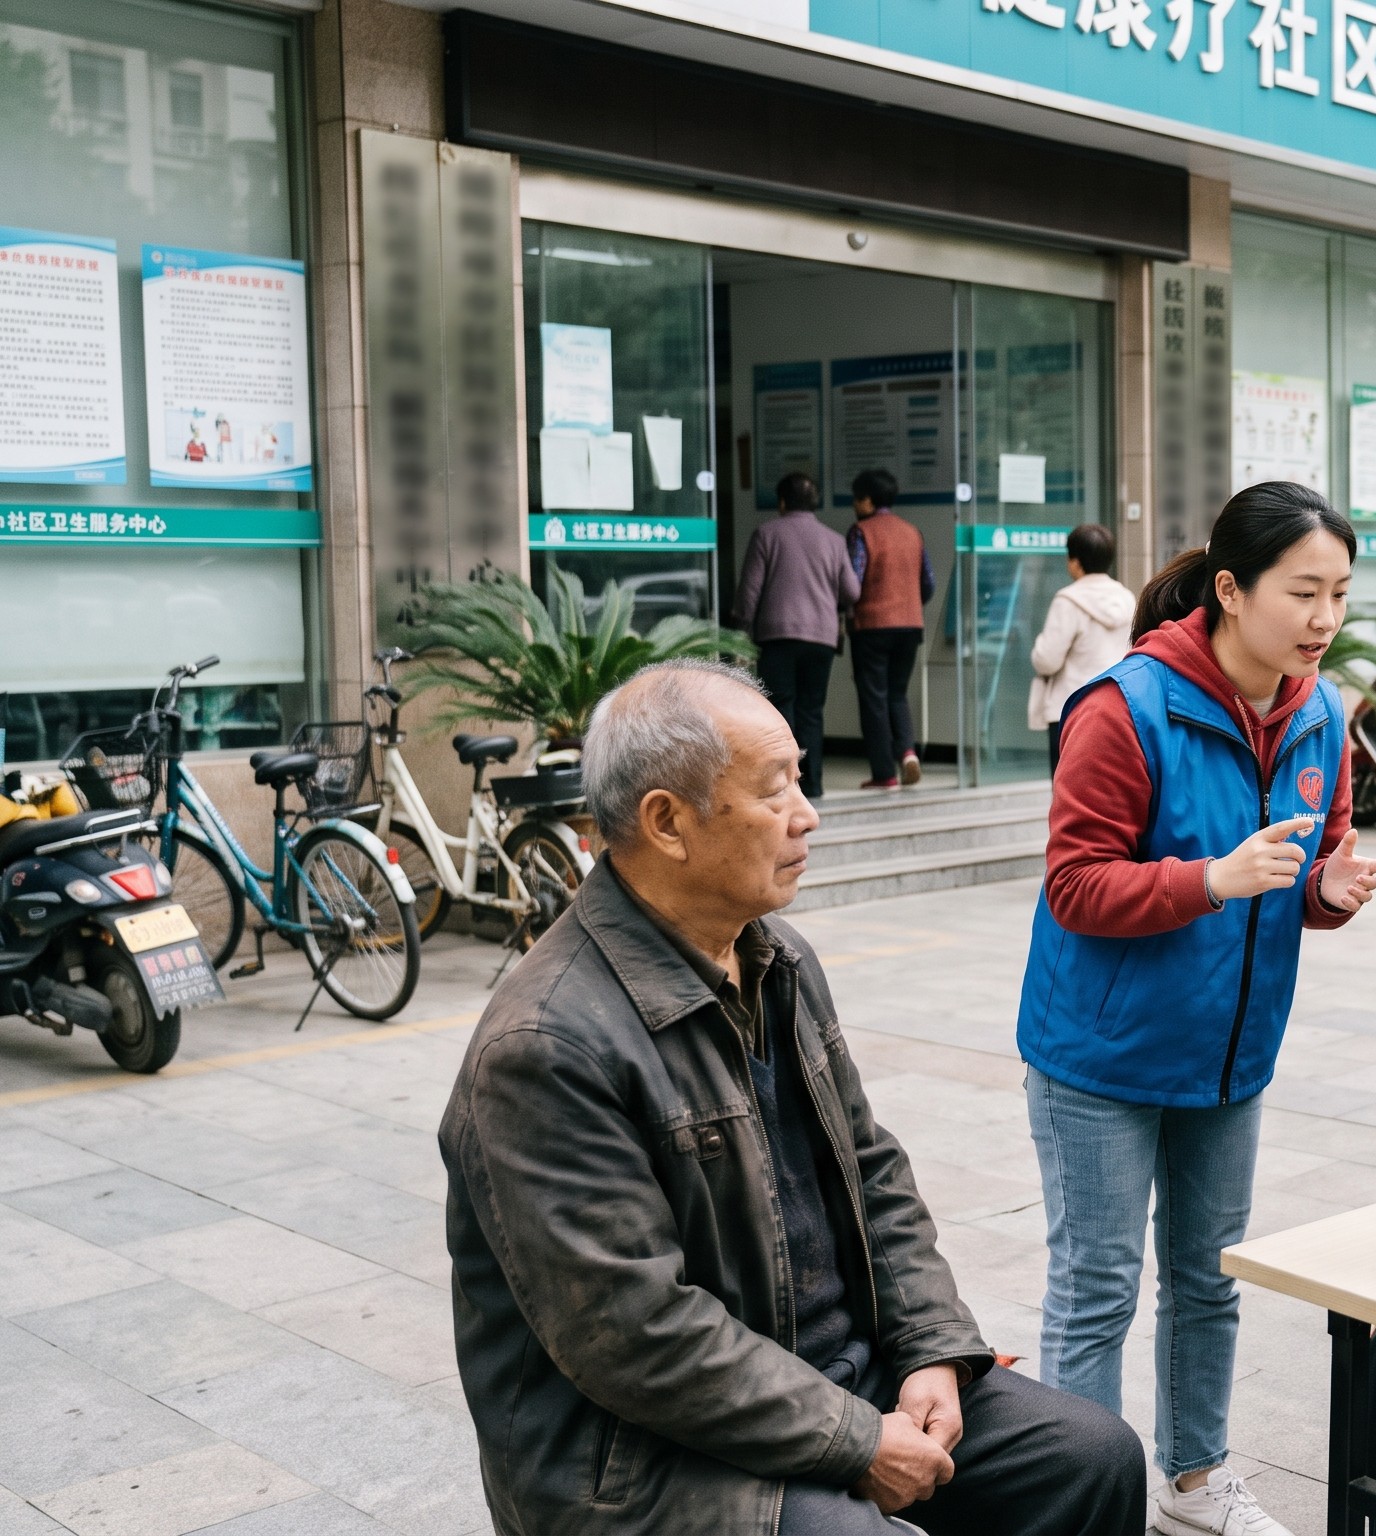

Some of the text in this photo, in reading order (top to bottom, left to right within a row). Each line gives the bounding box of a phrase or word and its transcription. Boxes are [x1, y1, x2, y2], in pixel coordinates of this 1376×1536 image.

[7, 511, 167, 535] 社区卫生服务中心
